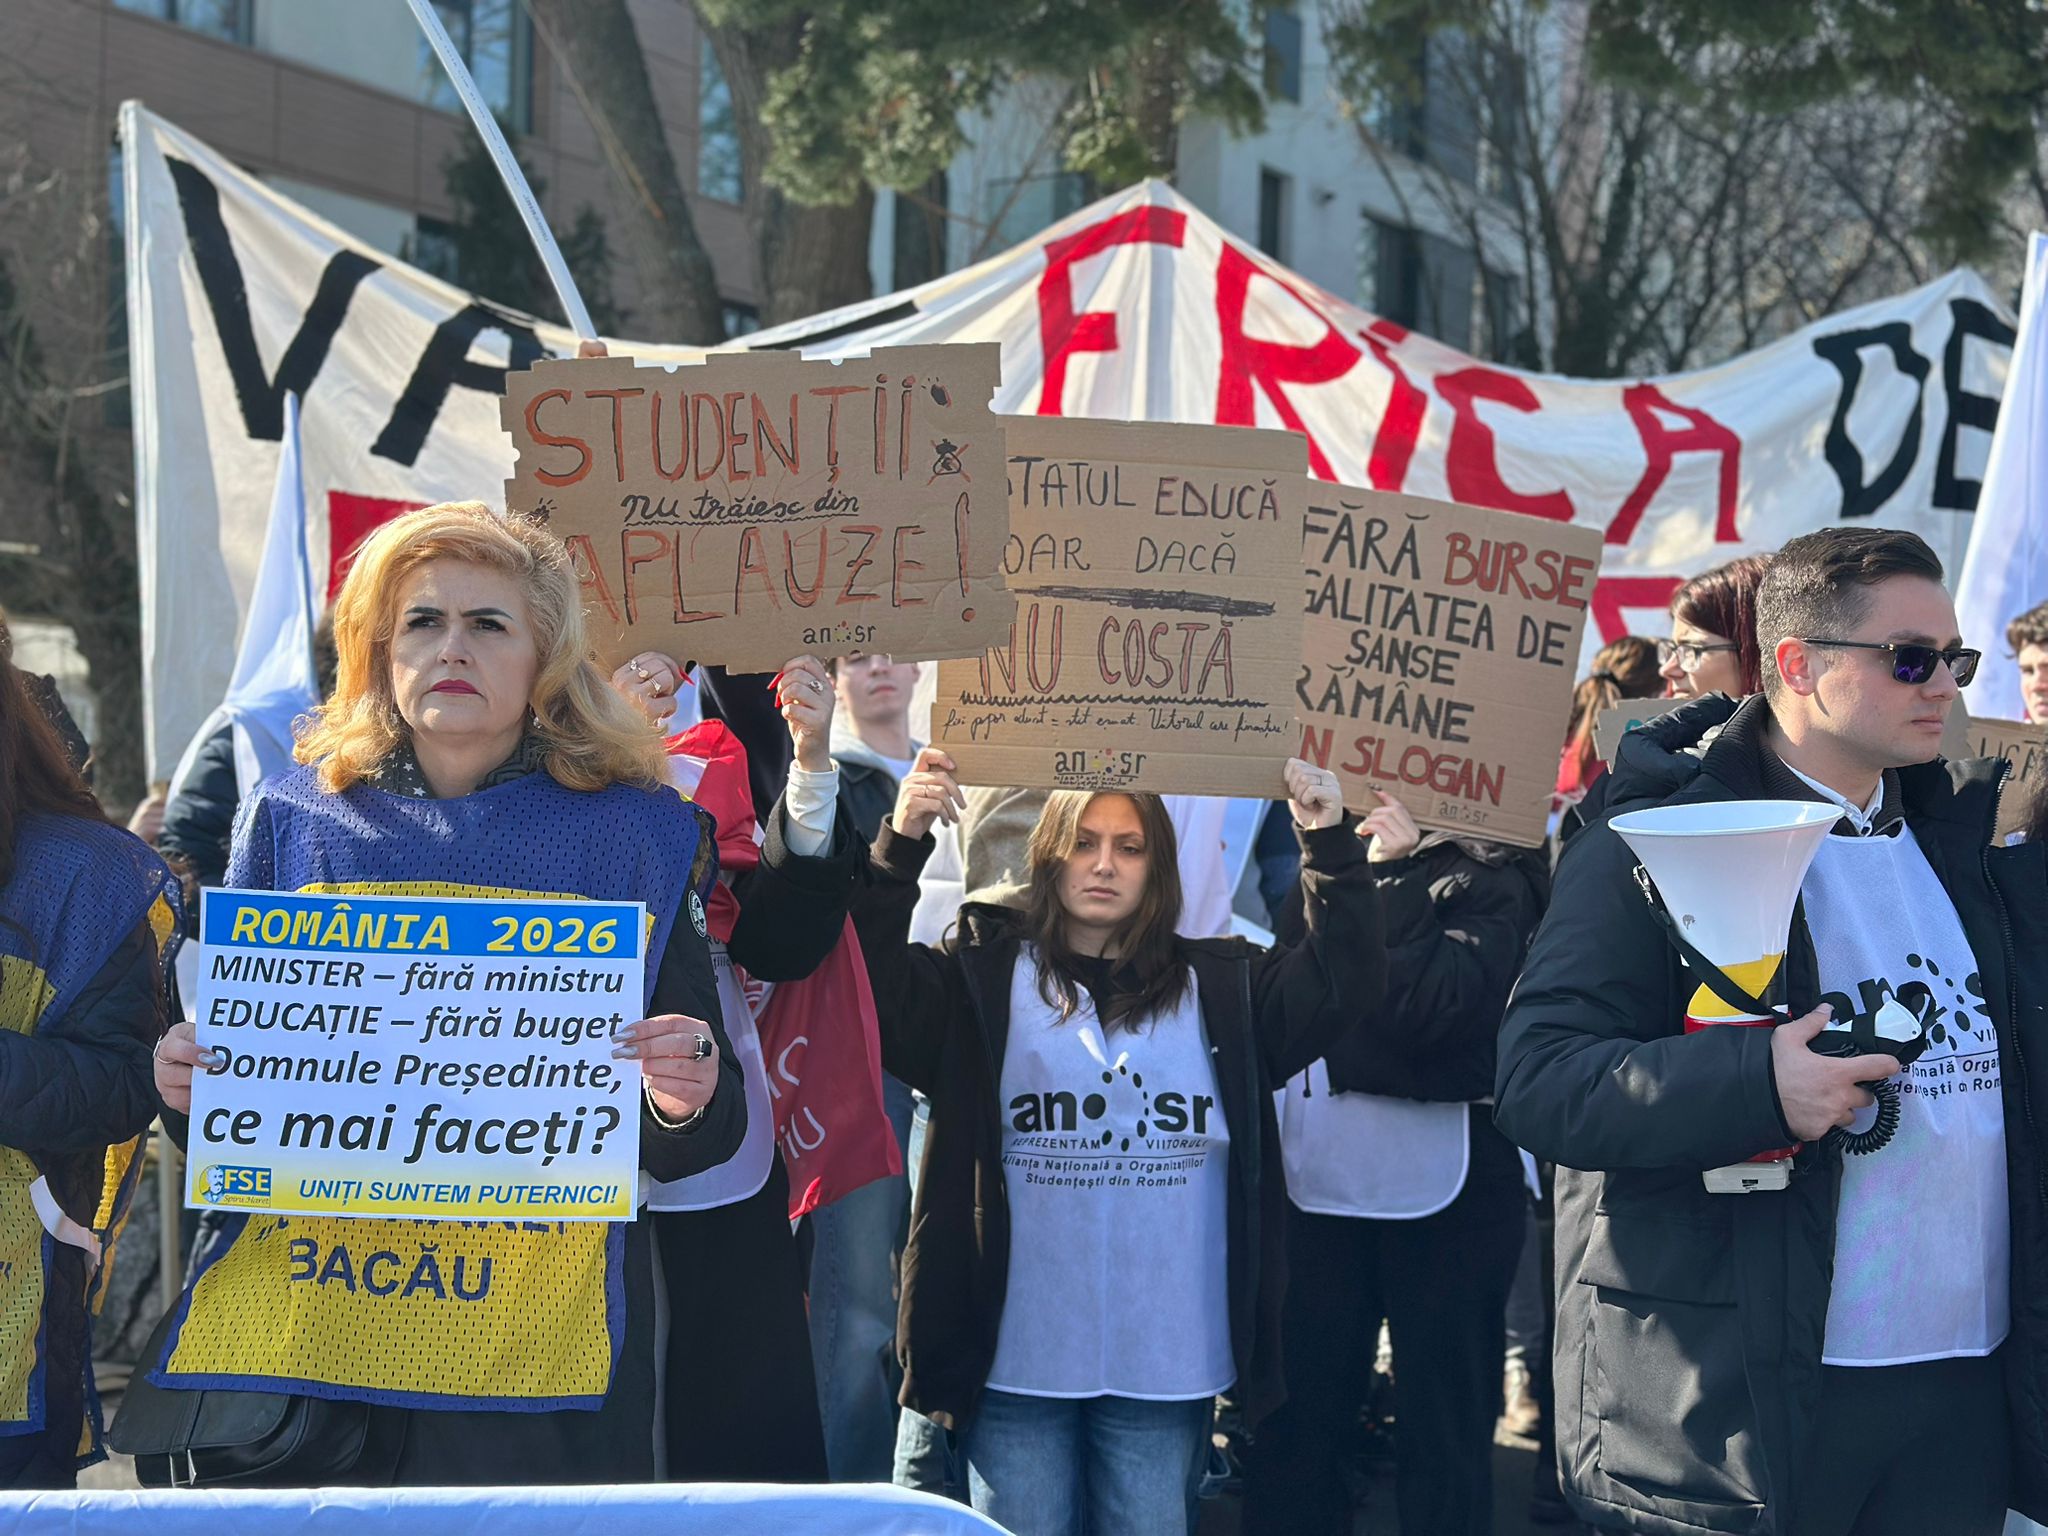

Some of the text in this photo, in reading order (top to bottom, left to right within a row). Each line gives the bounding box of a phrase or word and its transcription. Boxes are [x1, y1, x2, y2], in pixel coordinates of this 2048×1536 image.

[1813, 298, 2018, 520] DE
[622, 487, 860, 521] nu trăiesc din
[1003, 455, 1281, 522] TATUL EDUCĂ
[1002, 530, 1237, 576] OAR DACĂ
[1301, 500, 1431, 581] FĂRĂ
[1303, 568, 1573, 668] GALITATEA DE
[979, 601, 1235, 699] NU COSTĂ
[1344, 628, 1461, 687] ȘANSE
[1295, 662, 1477, 745] RĂMÂNE
[1299, 721, 1507, 808] N SLOGAN
[230, 902, 619, 954] ROMÂNIA 2026
[209, 953, 365, 988] MINISTER
[398, 961, 475, 996] fără
[483, 964, 624, 994] ministru
[207, 997, 383, 1041] EDUCAȚIE
[419, 1005, 502, 1045] fără
[511, 1007, 623, 1046] buget
[206, 1043, 623, 1095] Domnule Președinte,
[201, 1102, 622, 1168] ce mai faceți?
[223, 1168, 271, 1193] FSE
[1001, 1154, 1205, 1173] Alianța Națională a Organizațiilor
[1025, 1172, 1188, 1189] Studențești din România
[298, 1178, 619, 1206] UNIȚI SUNTEM PUTERNICI!
[289, 1237, 493, 1301] BACĂU
